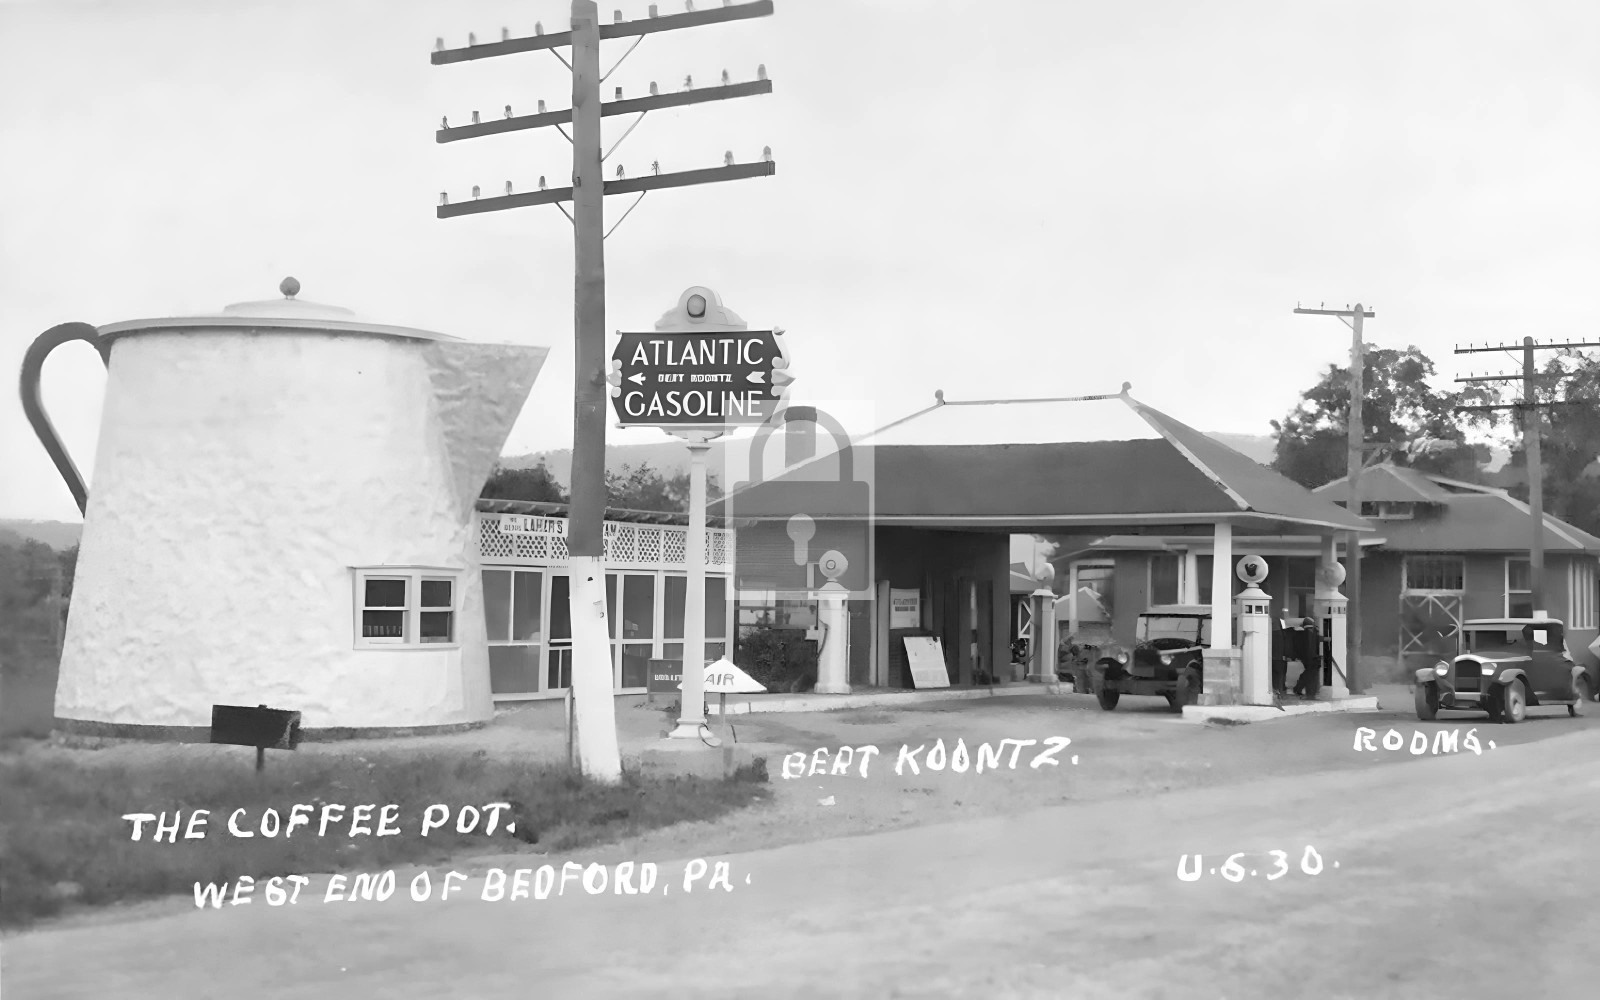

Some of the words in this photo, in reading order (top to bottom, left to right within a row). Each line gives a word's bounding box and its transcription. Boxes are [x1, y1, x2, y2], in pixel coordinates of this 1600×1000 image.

[630, 338, 764, 366] ATLANTIC
[624, 390, 763, 417] GASOLINE
[704, 673, 735, 686] AIR
